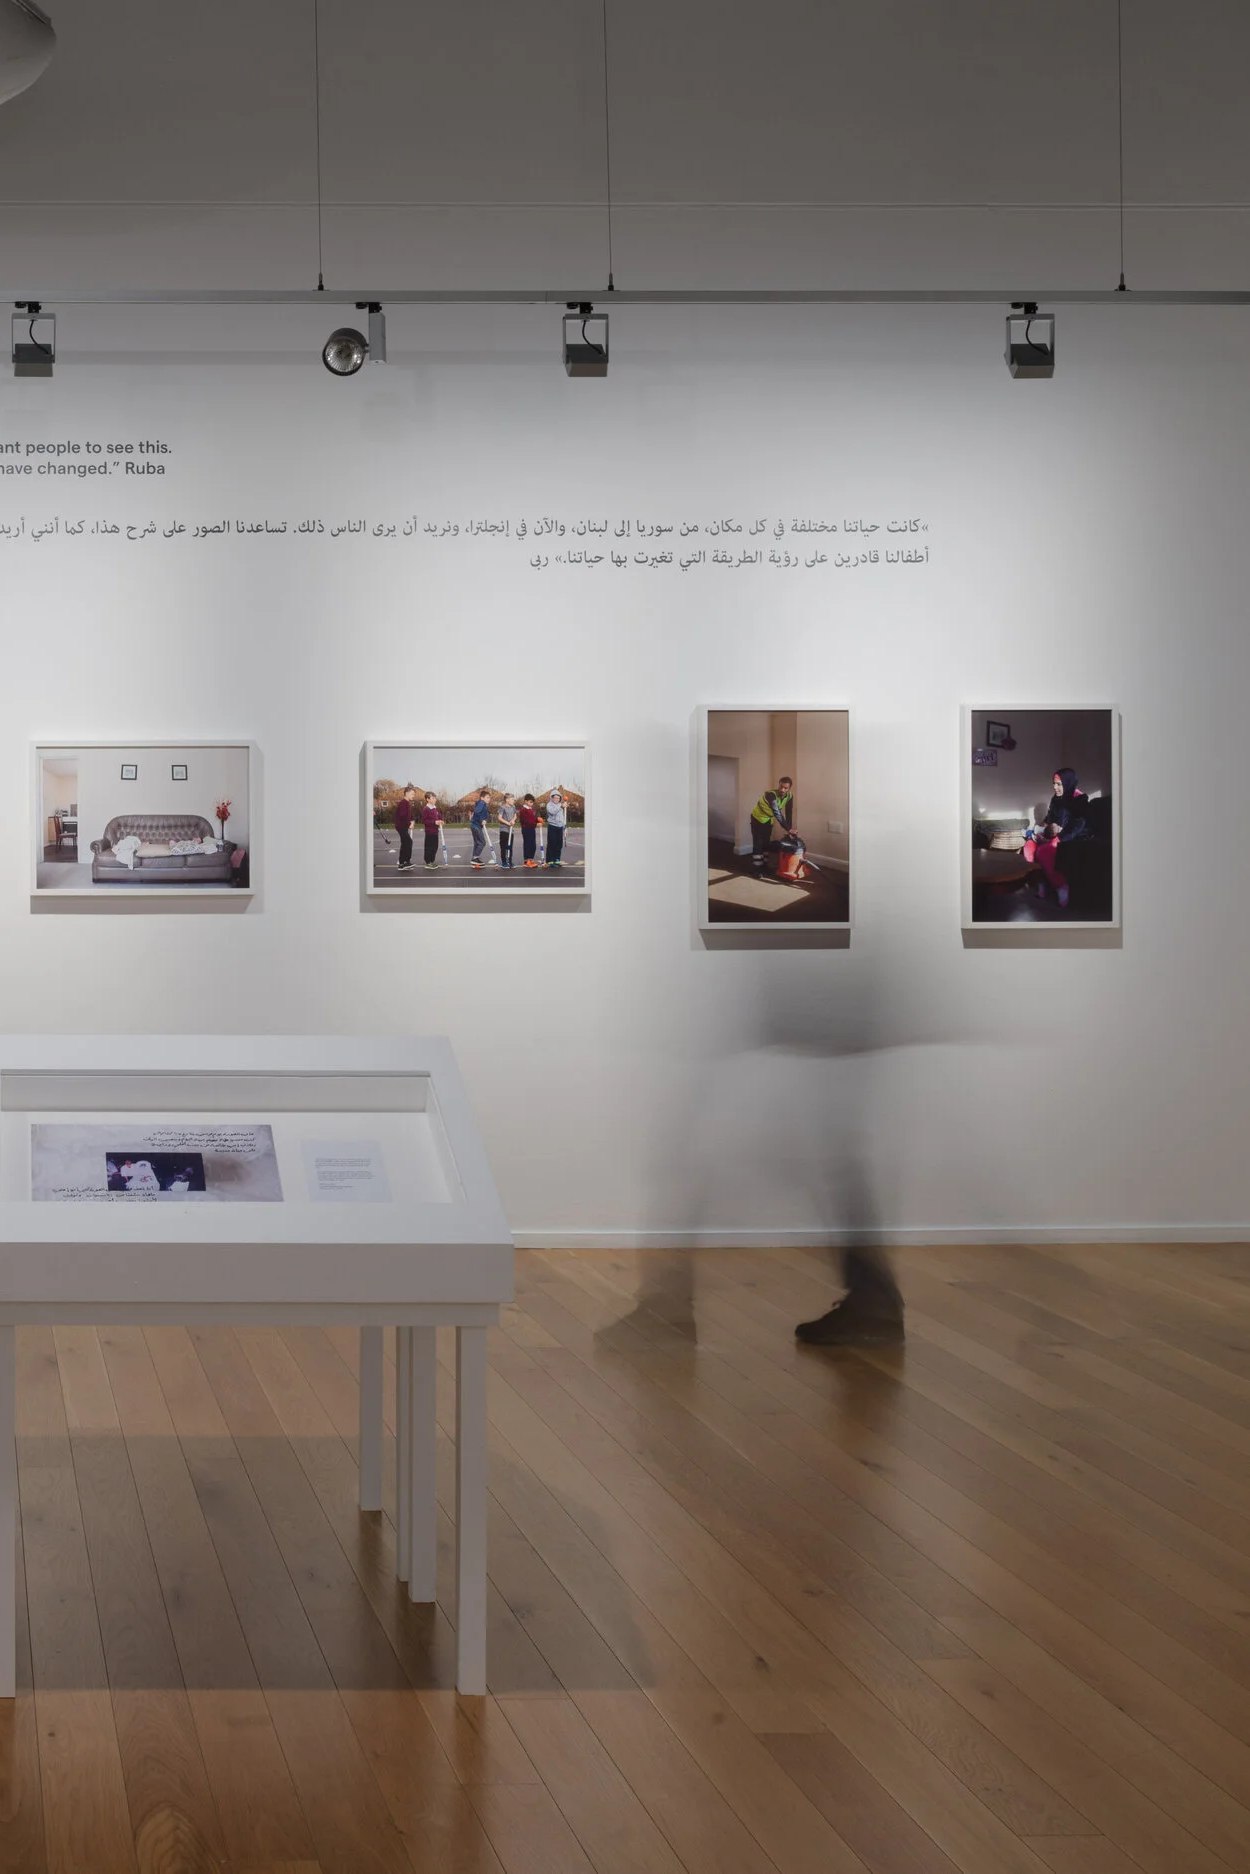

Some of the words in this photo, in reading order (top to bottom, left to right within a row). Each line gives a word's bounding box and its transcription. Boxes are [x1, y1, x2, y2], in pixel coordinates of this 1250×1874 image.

[25, 440, 81, 457] people
[84, 441, 103, 454] to
[106, 443, 135, 454] see
[137, 439, 172, 454] this.
[125, 461, 166, 475] Ruba
[30, 516, 59, 543] أنني
[64, 519, 86, 536] كما
[126, 520, 157, 541] شرح
[162, 519, 187, 539] على
[191, 519, 231, 539] الصور
[235, 519, 288, 534] تساعدنا
[330, 519, 367, 538] الناس
[372, 523, 397, 538] يرى
[402, 514, 417, 537] أن
[423, 520, 460, 538] ونريد
[515, 518, 528, 541] في
[533, 517, 566, 537] والآن
[613, 519, 631, 538] إلى
[636, 519, 674, 538] سوريا
[679, 521, 700, 537] من
[748, 518, 768, 536] كل
[772, 518, 785, 541] في
[790, 518, 838, 533] مختلفة
[843, 519, 881, 538] حياتنا
[610, 550, 628, 569] بها
[633, 551, 674, 569] تغيرت
[679, 550, 706, 572] التي
[711, 549, 763, 569] الطريقة
[768, 549, 799, 569] رؤية
[804, 549, 829, 569] على
[834, 549, 880, 569] قادرين
[885, 545, 929, 564] أطفالنا
